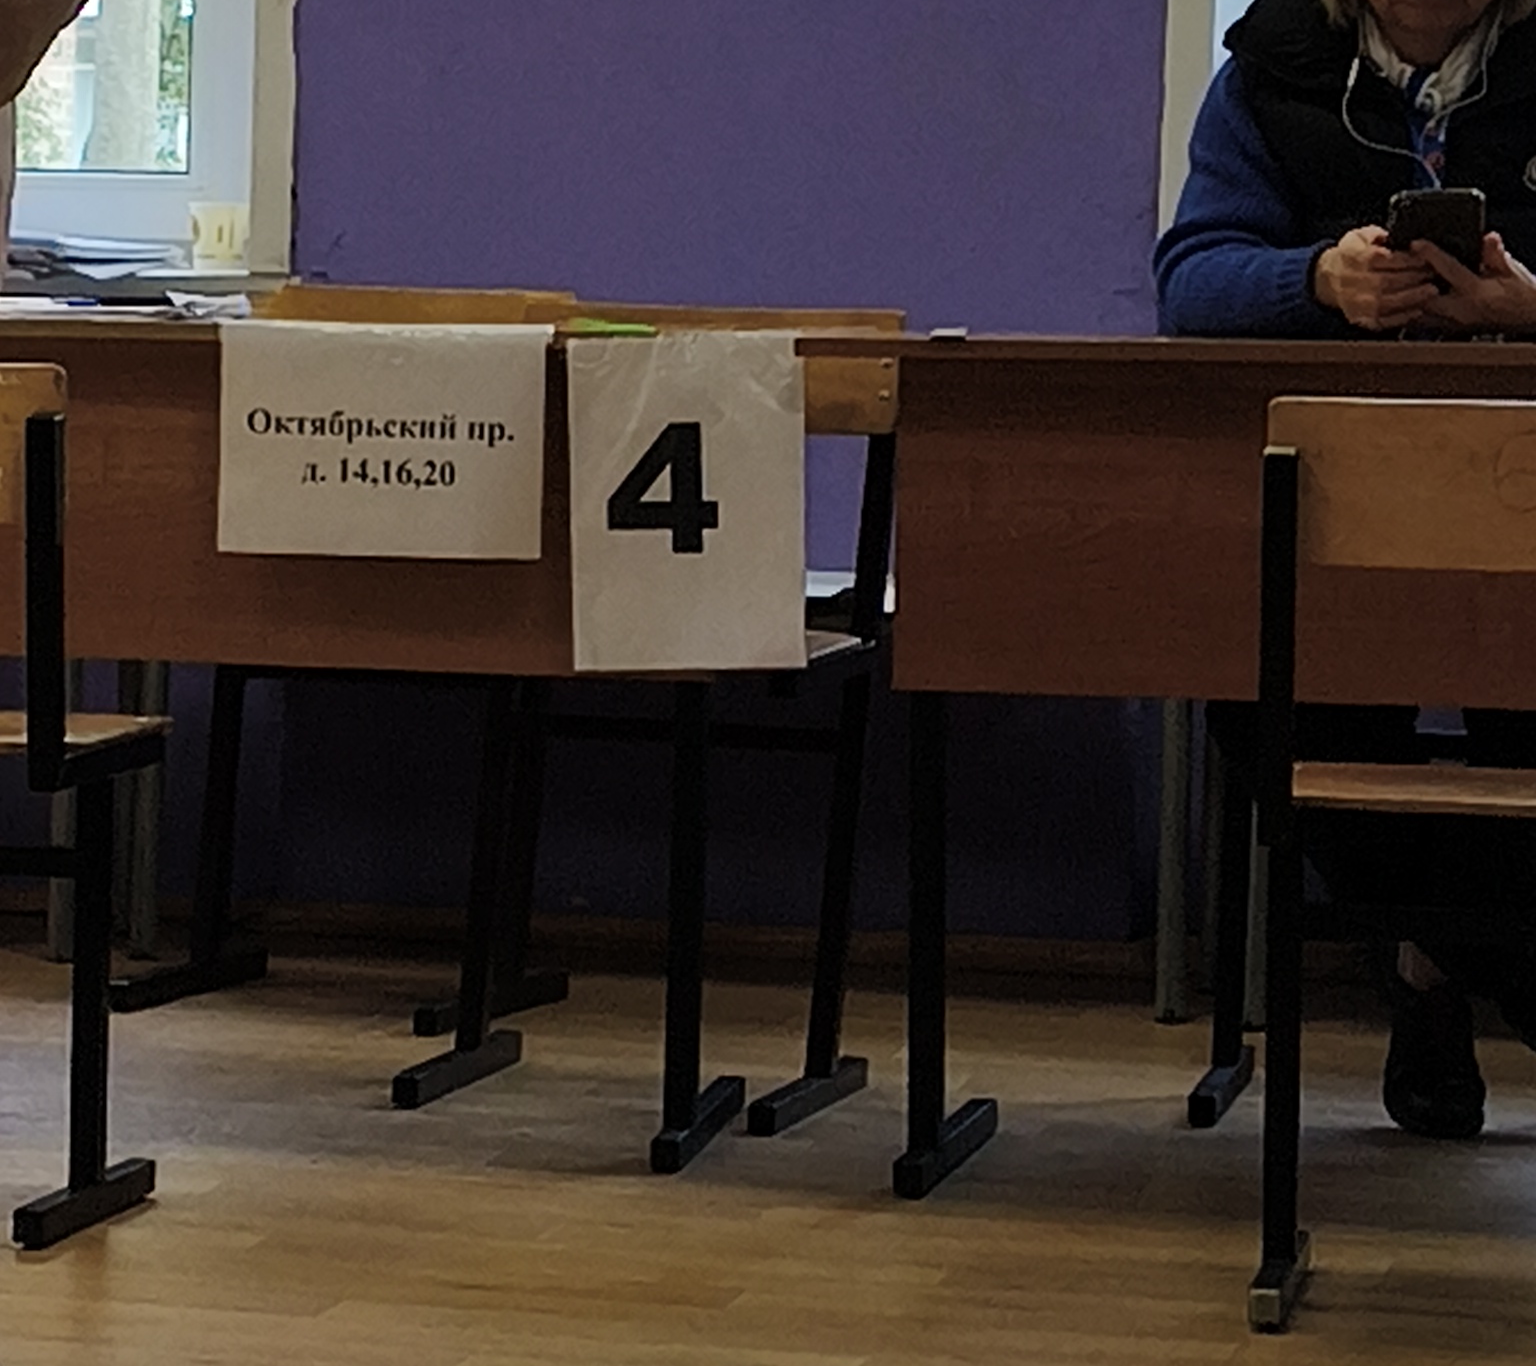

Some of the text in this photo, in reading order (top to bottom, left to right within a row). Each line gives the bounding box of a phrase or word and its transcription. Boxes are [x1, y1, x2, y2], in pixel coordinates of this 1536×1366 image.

[246, 407, 515, 448] Октябрьский пр.
[301, 458, 456, 491] д. 14,16,20
[607, 421, 719, 554] 4
